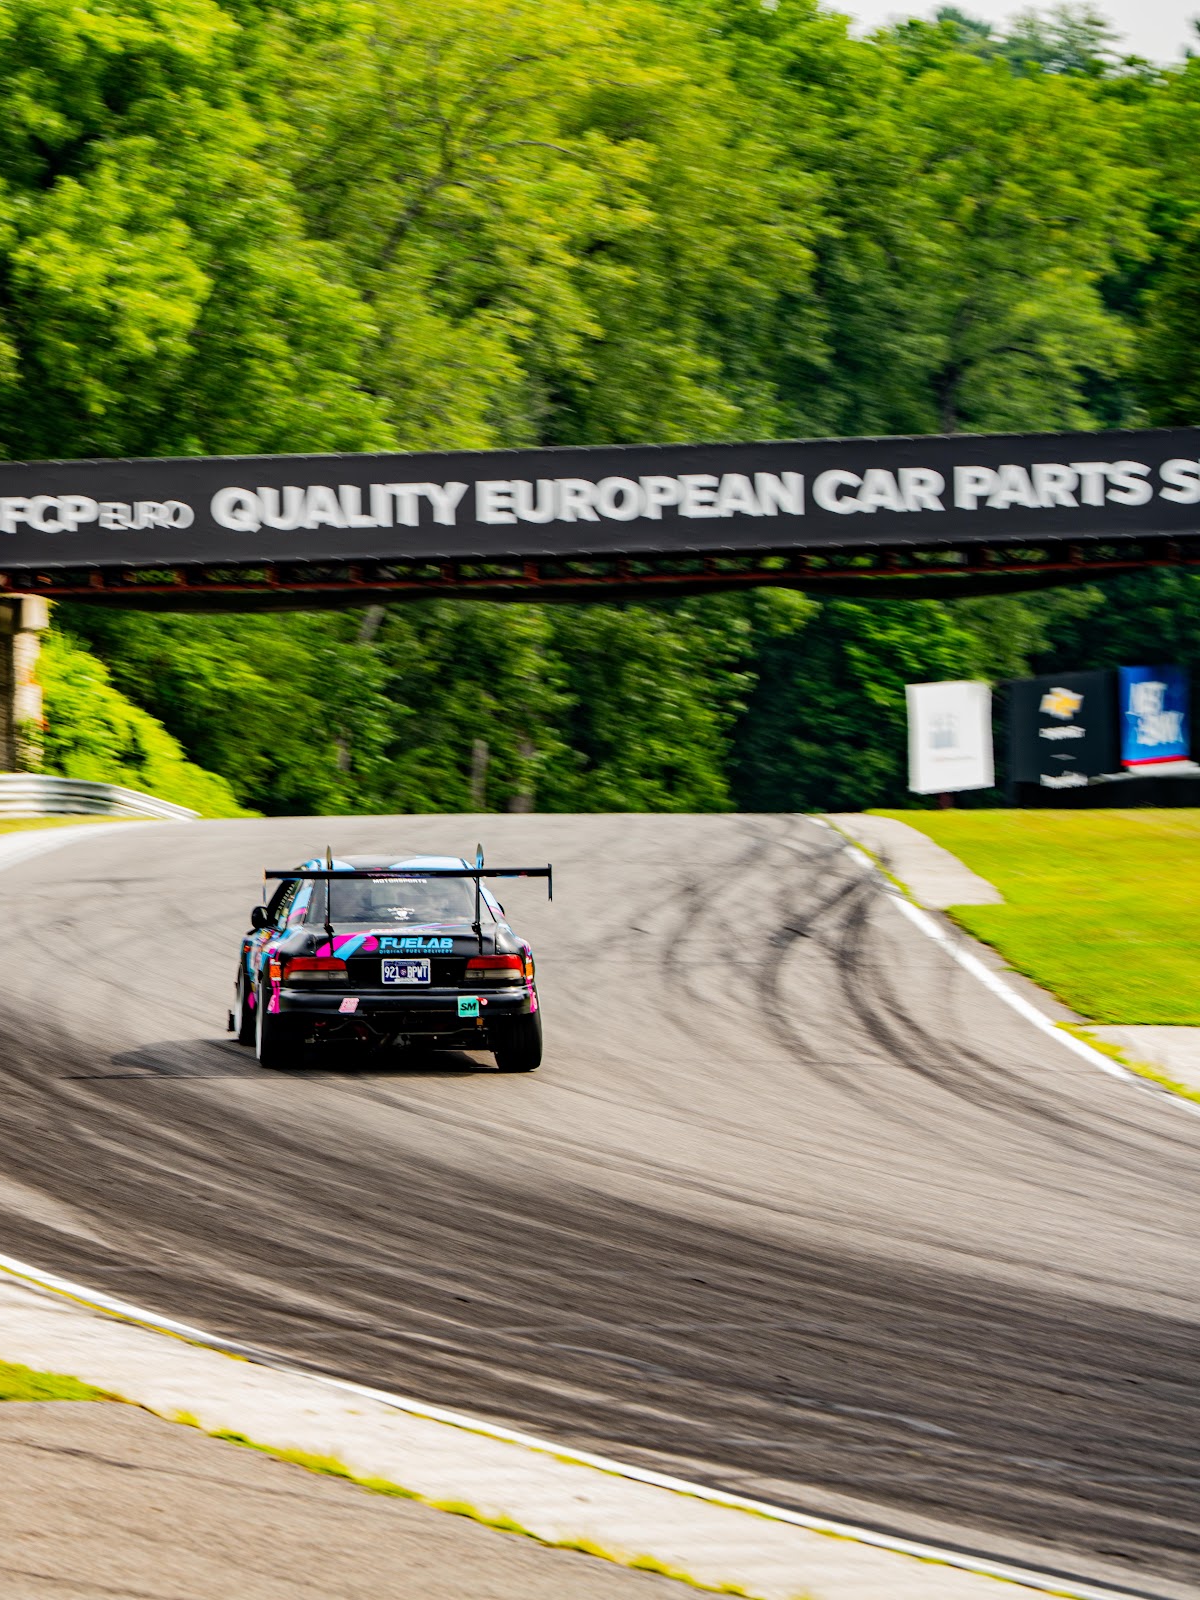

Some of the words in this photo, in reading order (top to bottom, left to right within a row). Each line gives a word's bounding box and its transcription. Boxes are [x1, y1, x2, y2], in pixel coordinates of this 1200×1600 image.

[210, 481, 469, 533] QUALITY
[474, 471, 805, 525] EUROPEAN
[812, 467, 946, 515] CAR
[953, 460, 1153, 511] PARTS
[1158, 458, 1200, 505] S
[379, 937, 454, 949] FUELAB
[384, 965, 401, 979] 921
[460, 1002, 477, 1011] SM
